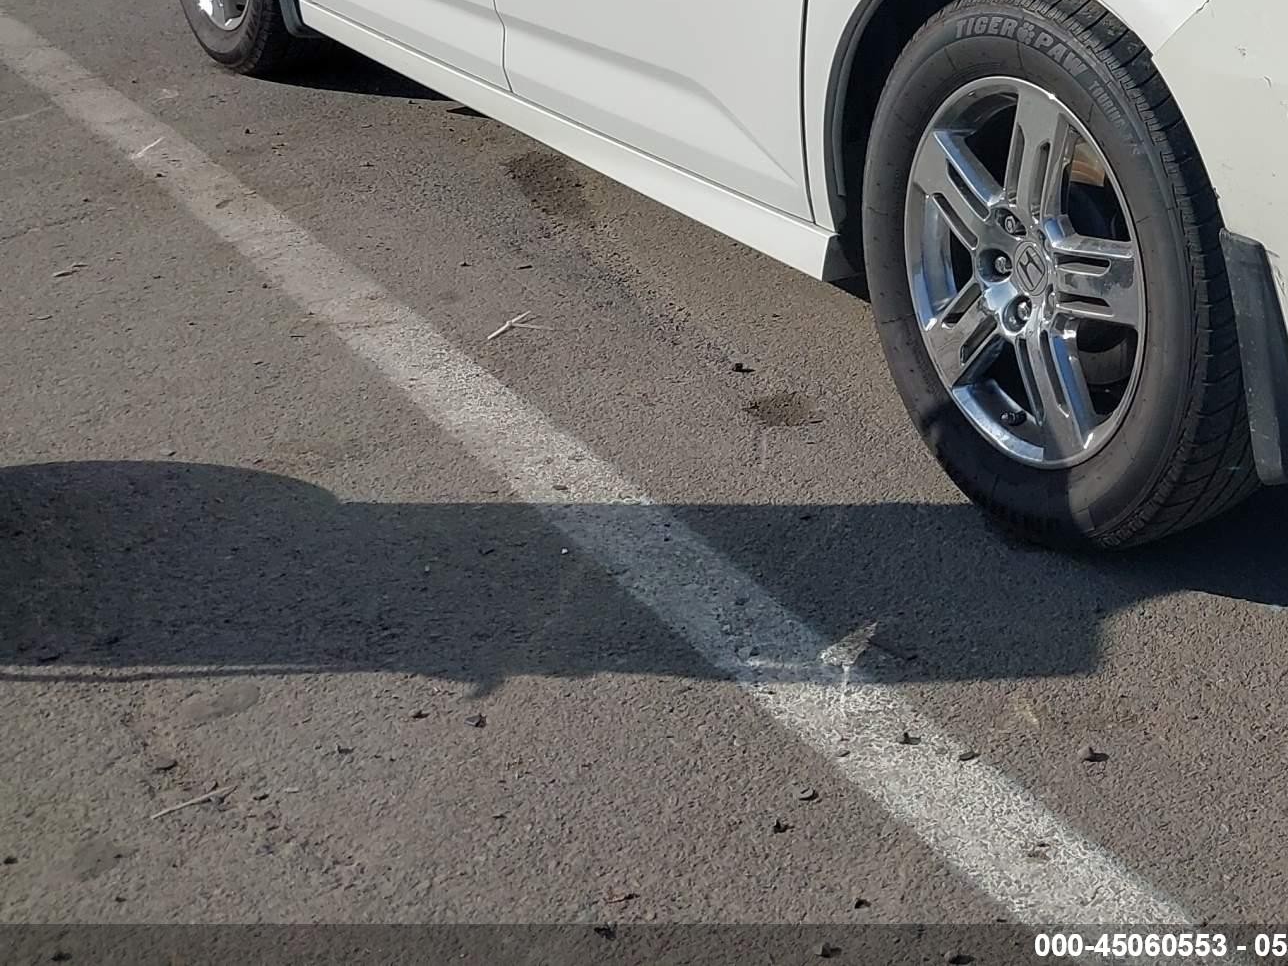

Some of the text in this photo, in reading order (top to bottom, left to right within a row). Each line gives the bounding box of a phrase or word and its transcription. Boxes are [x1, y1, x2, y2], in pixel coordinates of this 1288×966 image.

[955, 16, 1129, 129] TIGER PAW TOURING
